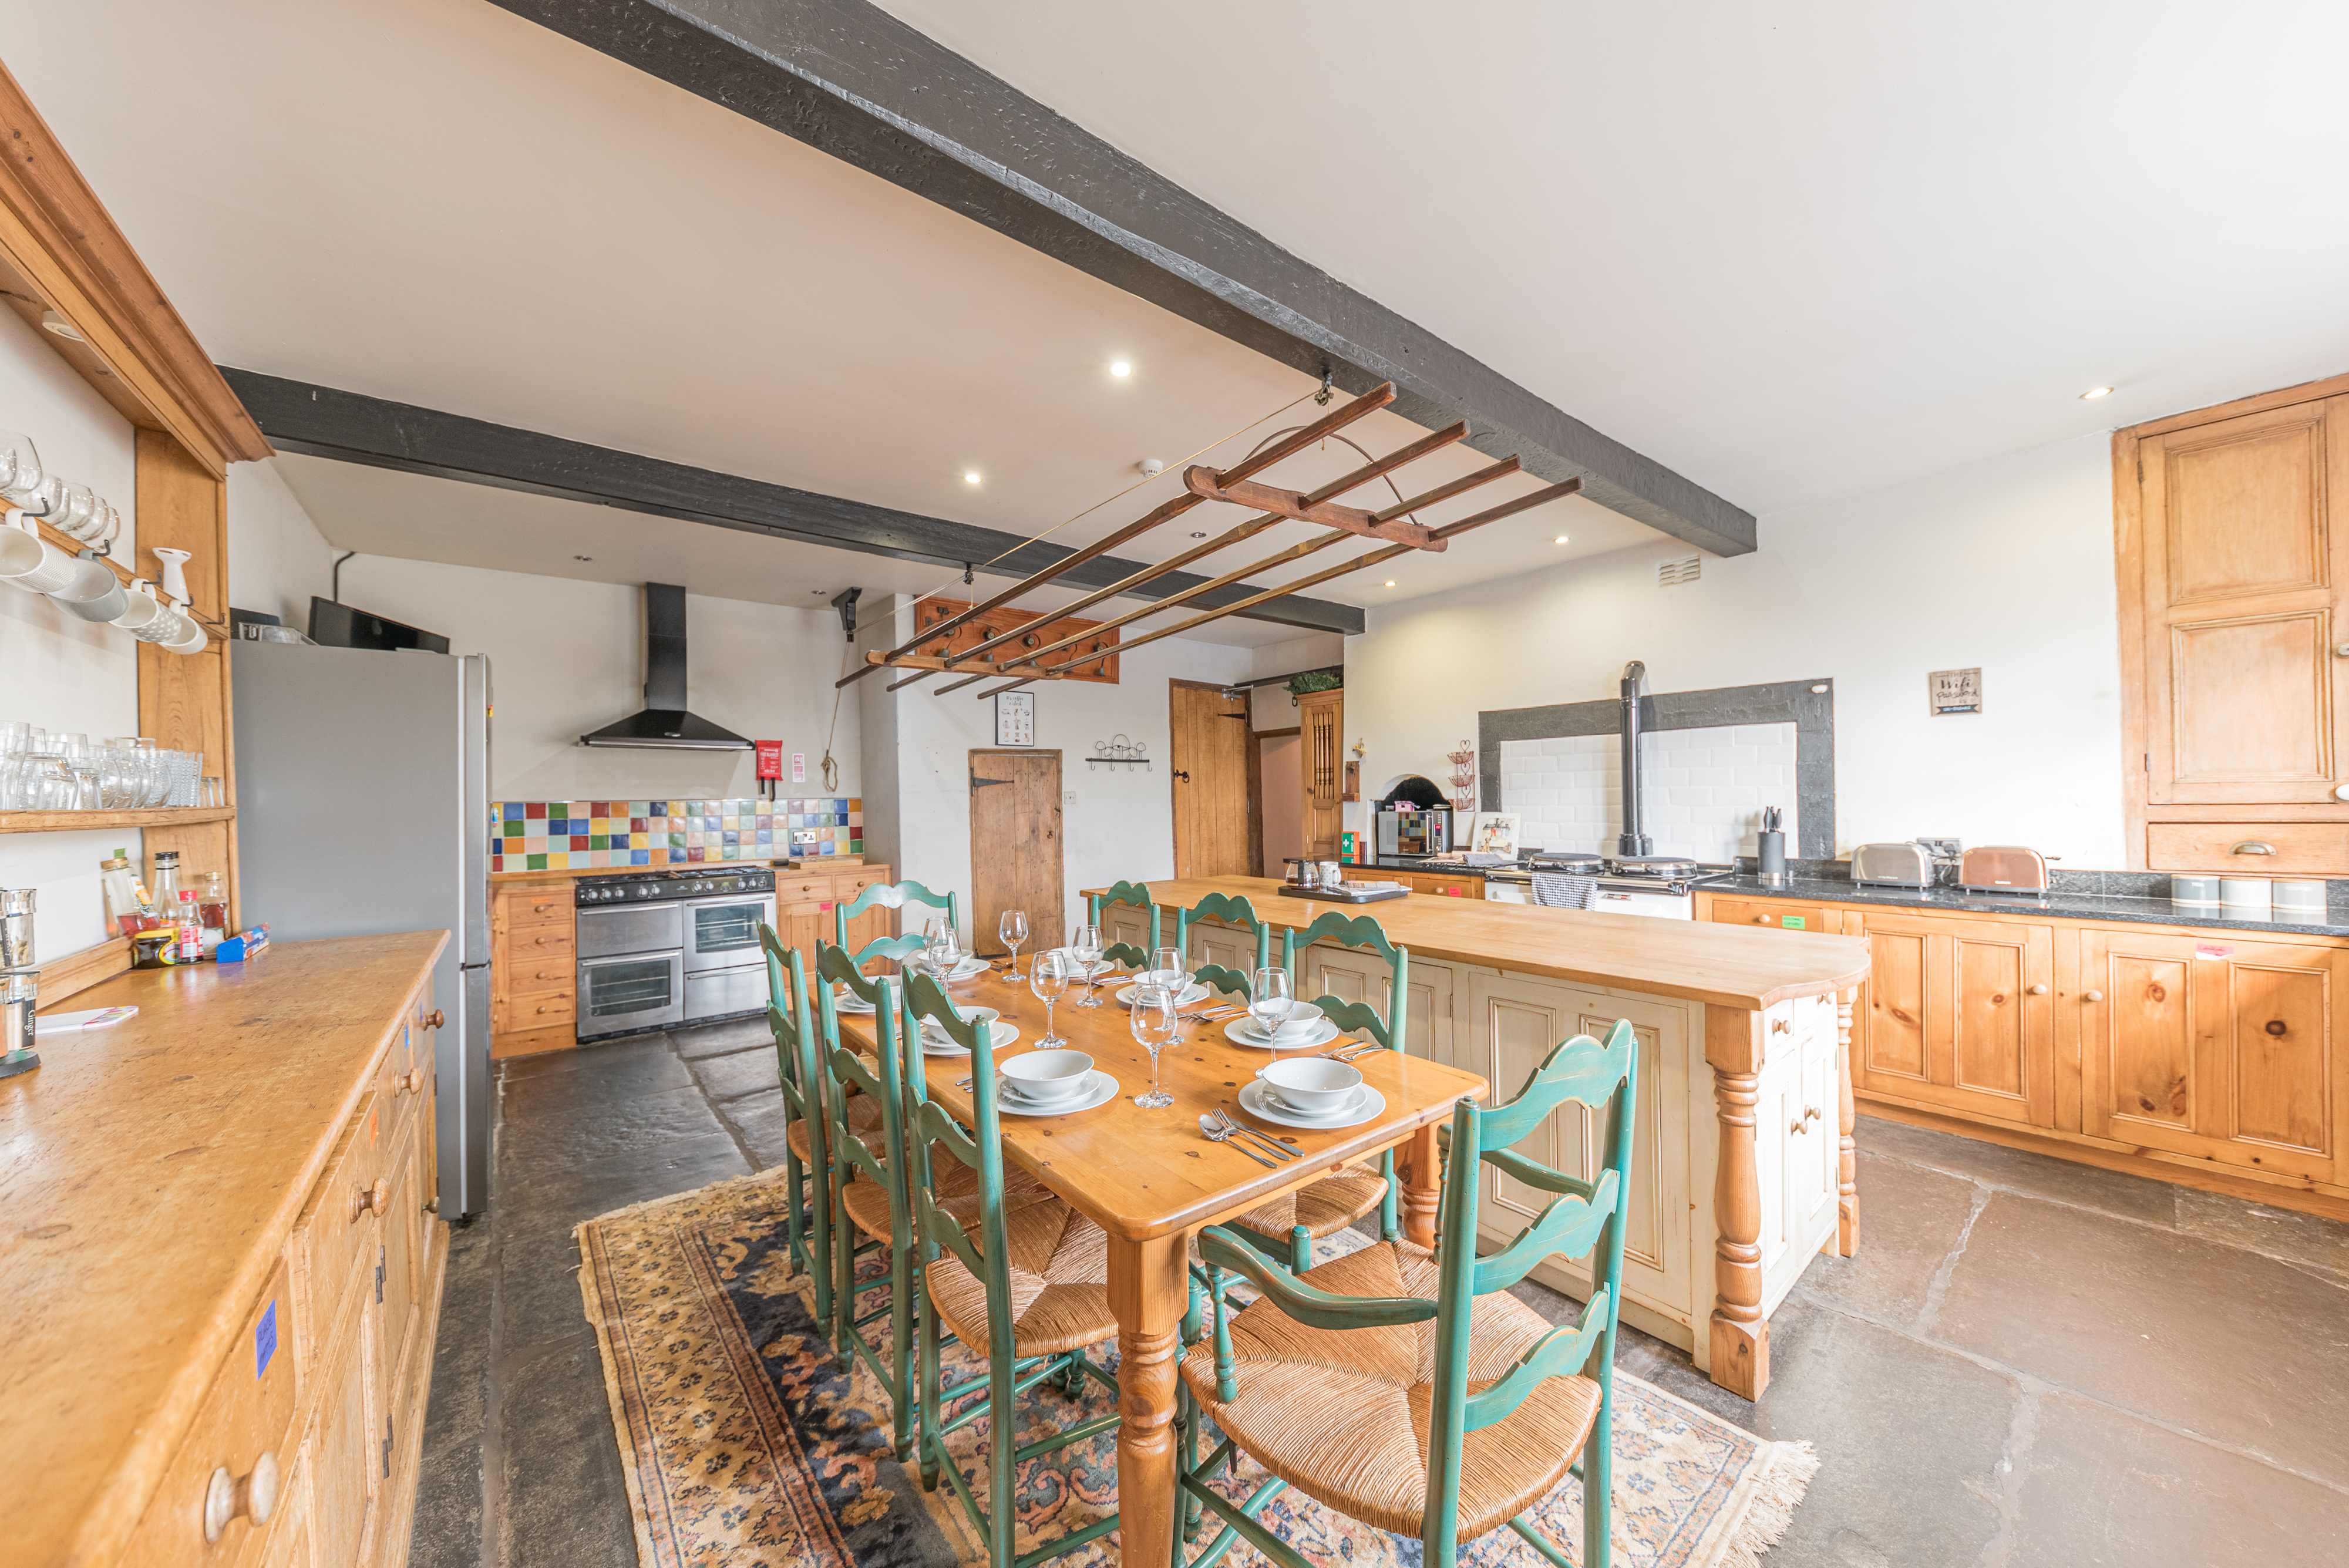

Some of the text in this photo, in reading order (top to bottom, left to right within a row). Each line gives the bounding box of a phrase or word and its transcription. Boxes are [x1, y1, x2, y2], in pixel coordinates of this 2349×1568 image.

[1941, 677, 1973, 691] Wifi
[24, 1010, 35, 1036] Ginger
[258, 1311, 272, 1345] PLACE
